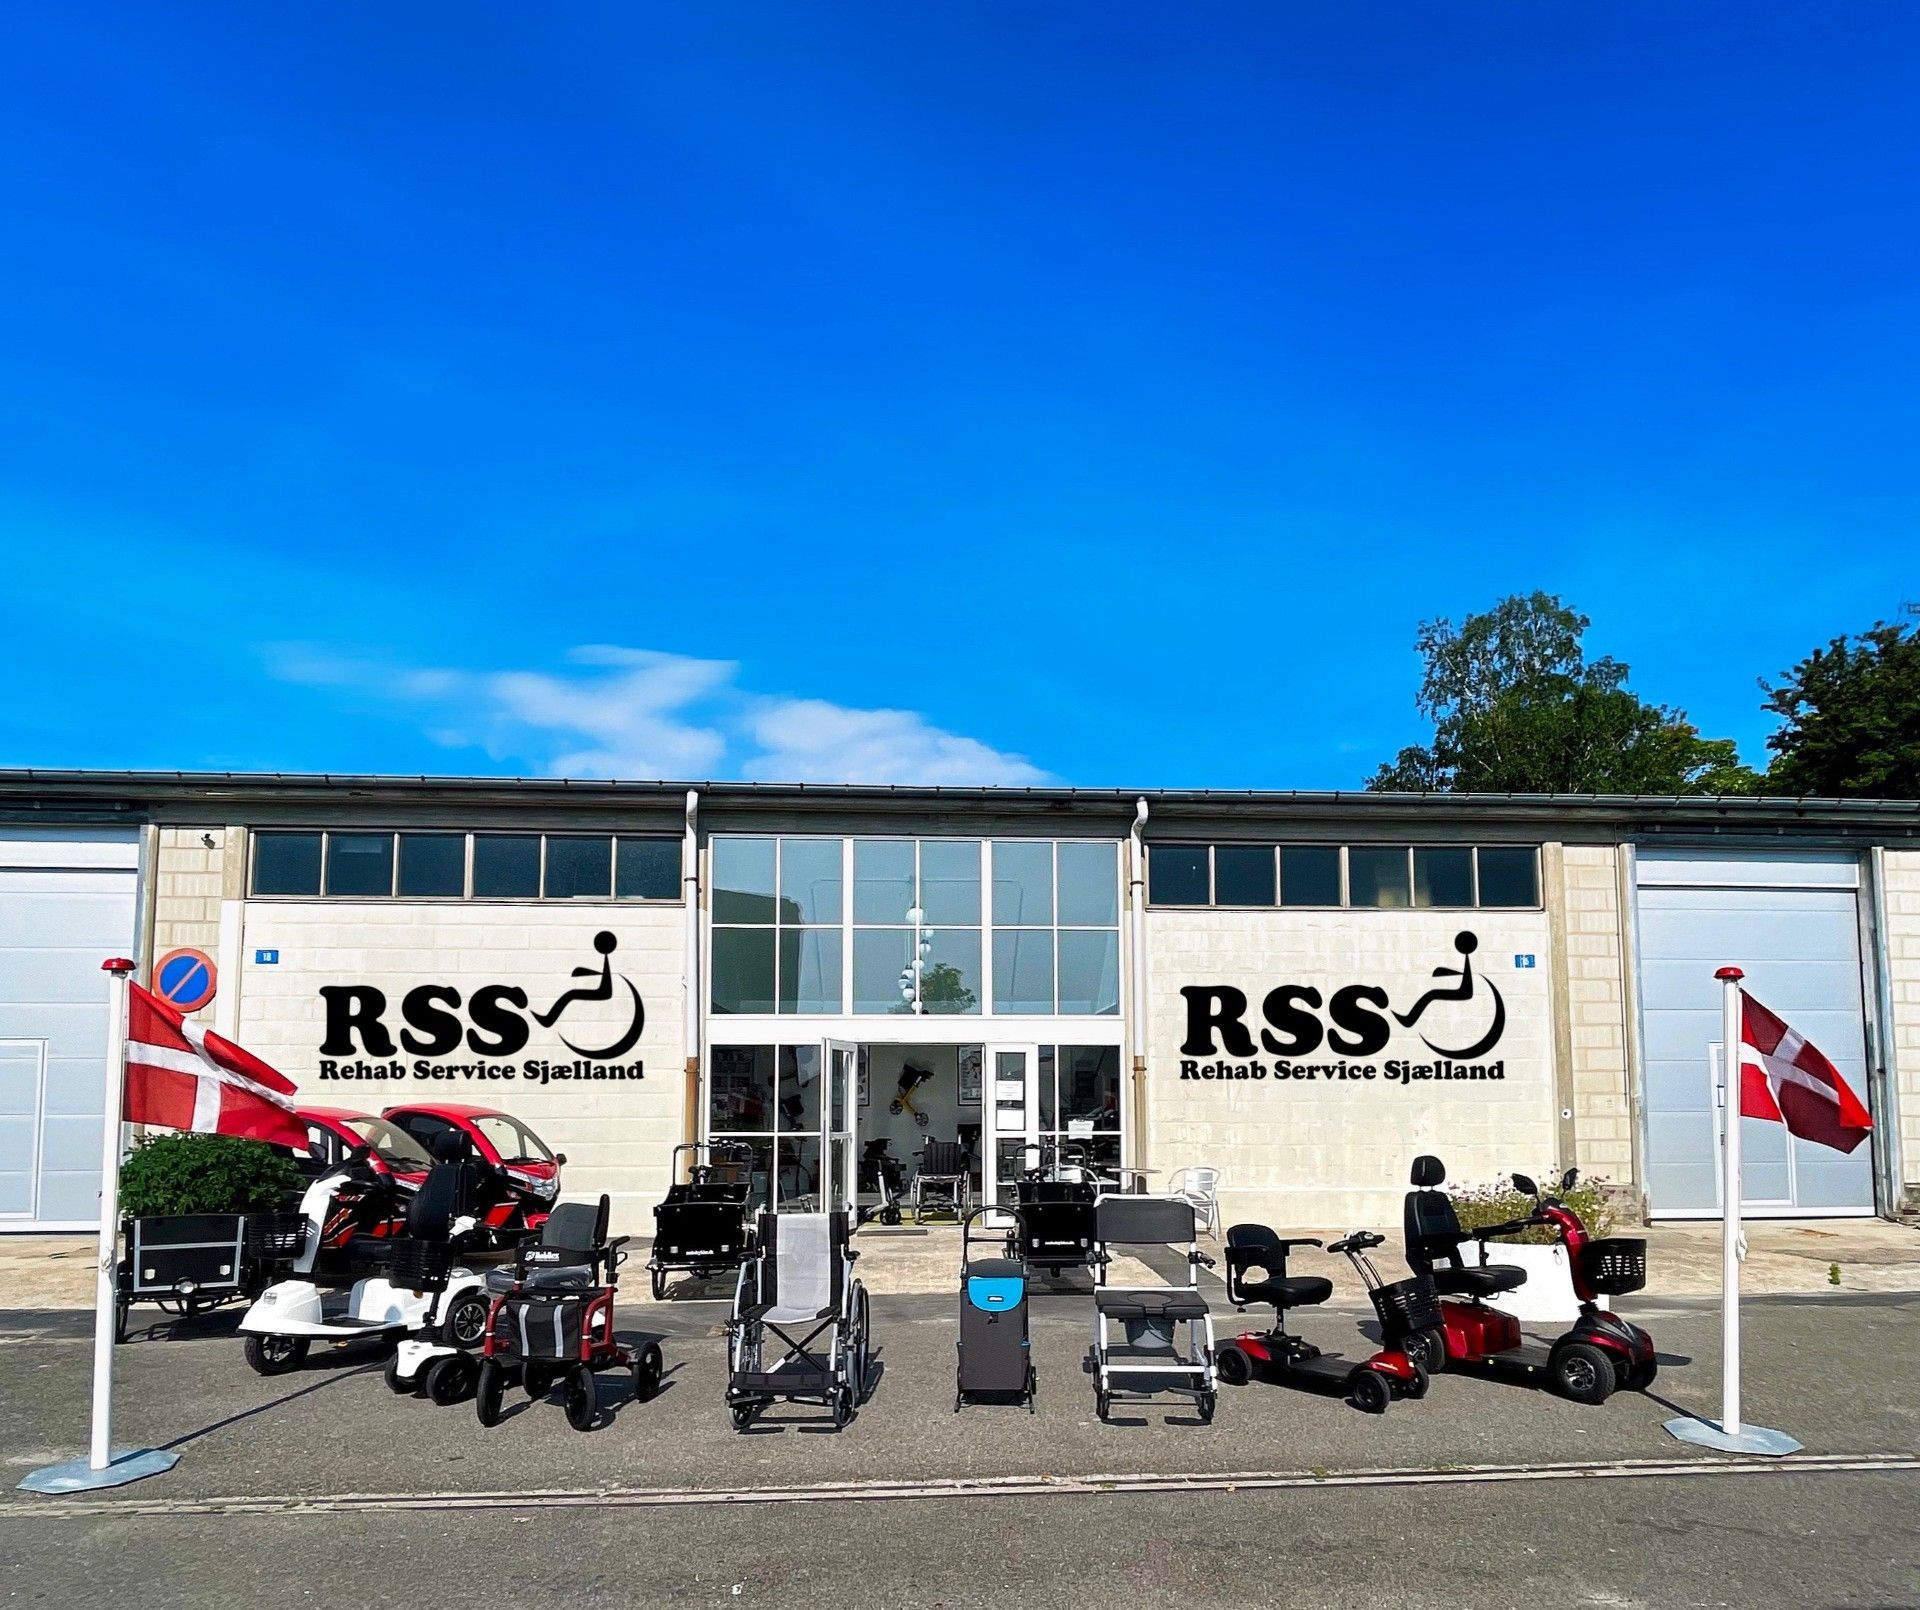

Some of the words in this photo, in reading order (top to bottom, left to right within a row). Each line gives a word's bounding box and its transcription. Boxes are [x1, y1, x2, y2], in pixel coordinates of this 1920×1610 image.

[318, 984, 530, 1058] RSS
[1179, 984, 1391, 1058] RSS
[318, 1059, 407, 1081] Rehab
[413, 1059, 516, 1081] Service
[522, 1059, 645, 1085] Sjælland
[1179, 1059, 1268, 1081] Rehab
[1273, 1059, 1377, 1081] Service
[1383, 1059, 1505, 1085] Sjælland
